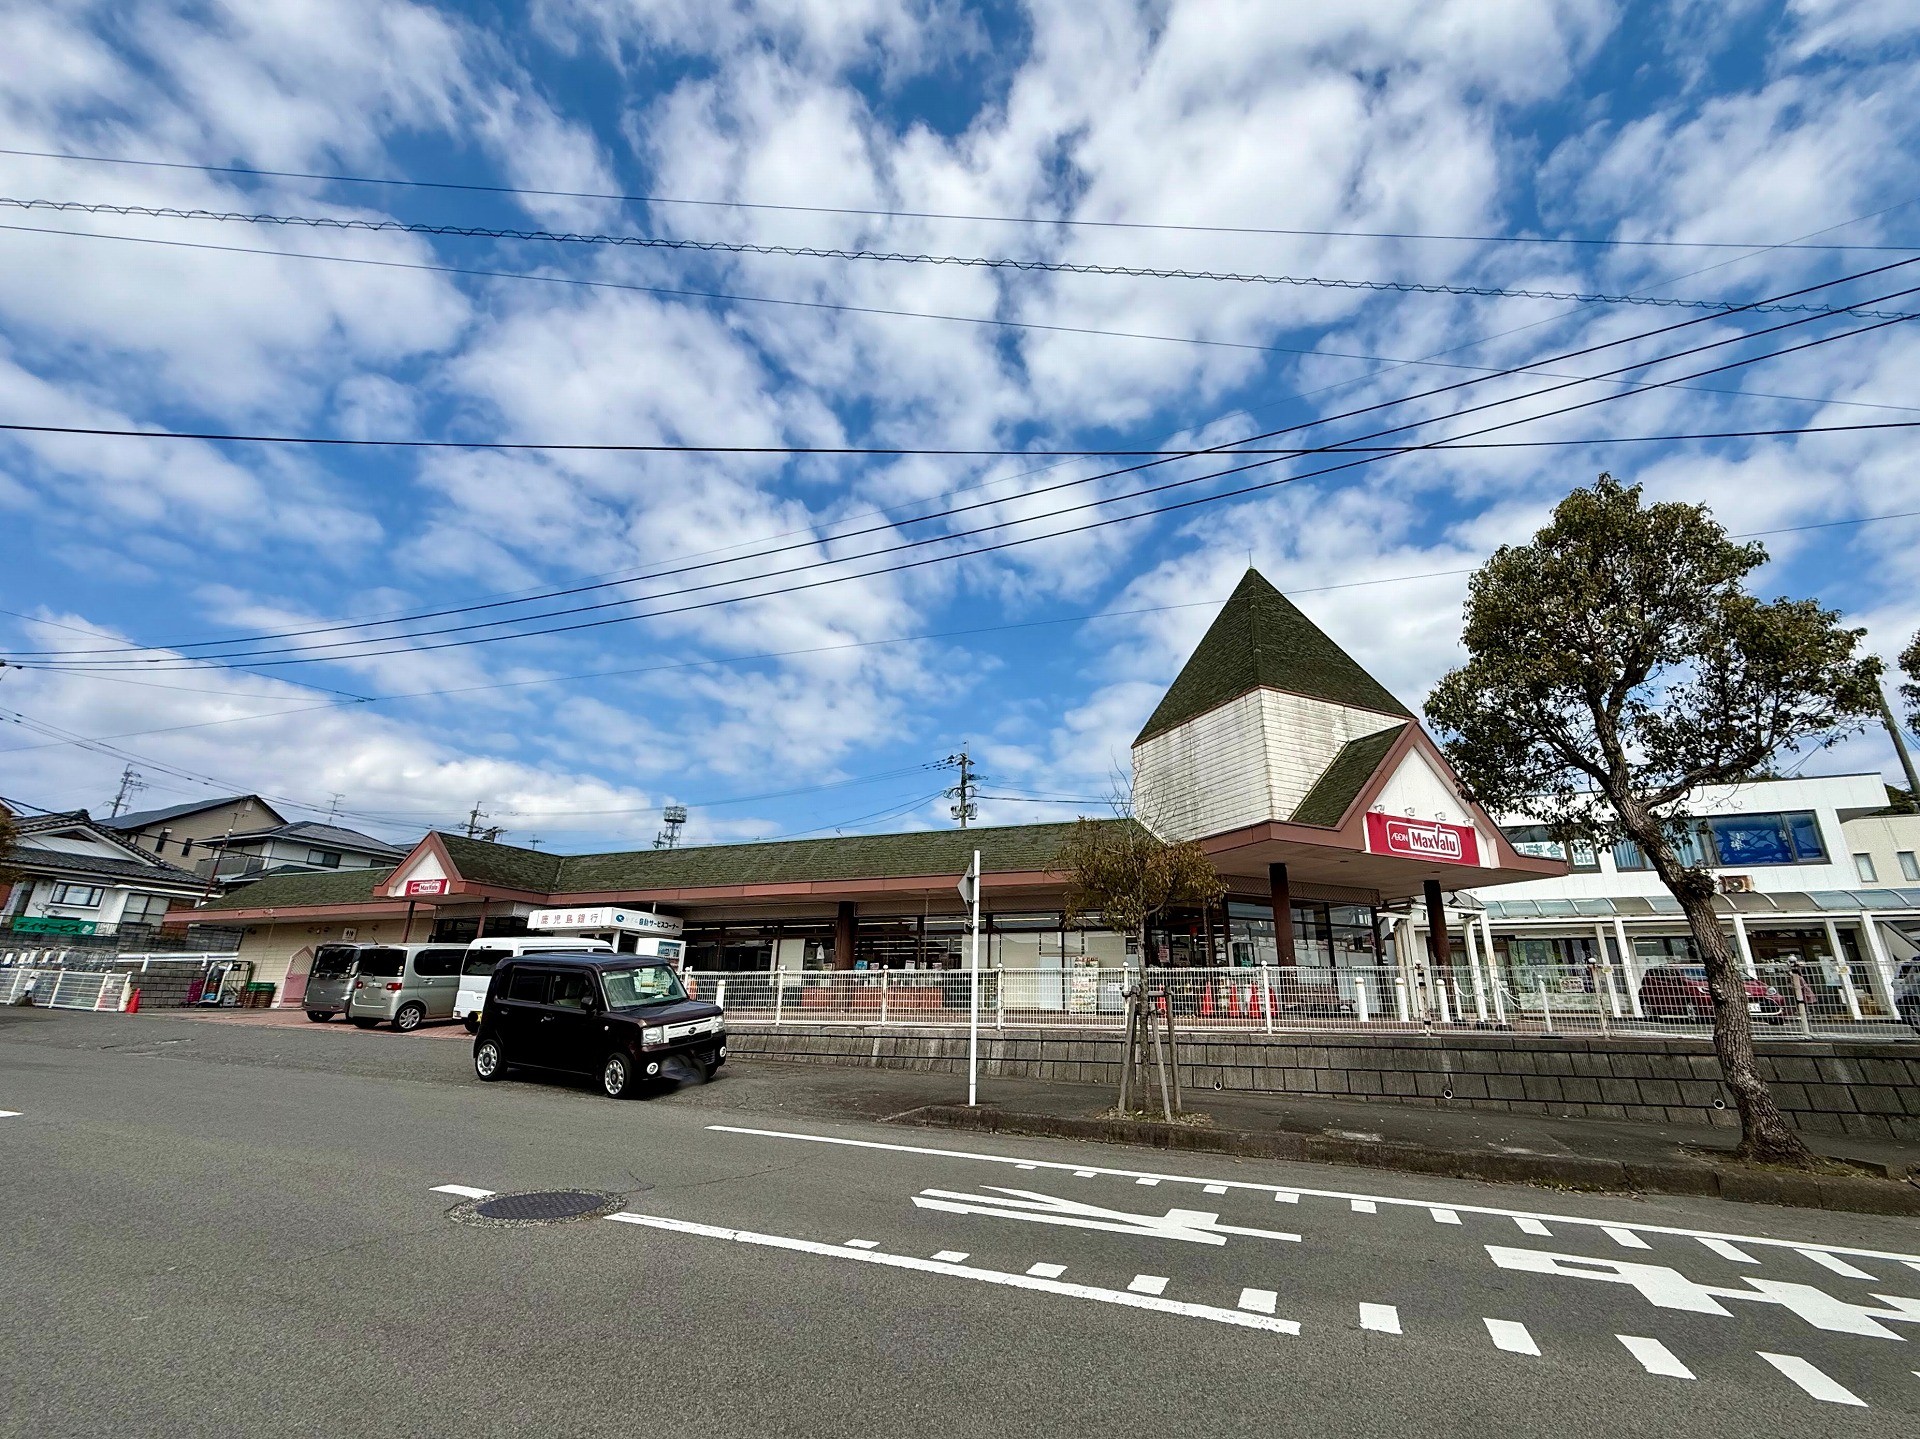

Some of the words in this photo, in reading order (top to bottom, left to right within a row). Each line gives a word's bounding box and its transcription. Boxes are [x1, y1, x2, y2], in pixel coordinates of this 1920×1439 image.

[1411, 825, 1456, 851] MaxValu
[540, 913, 599, 925] 鹿児島銀行
